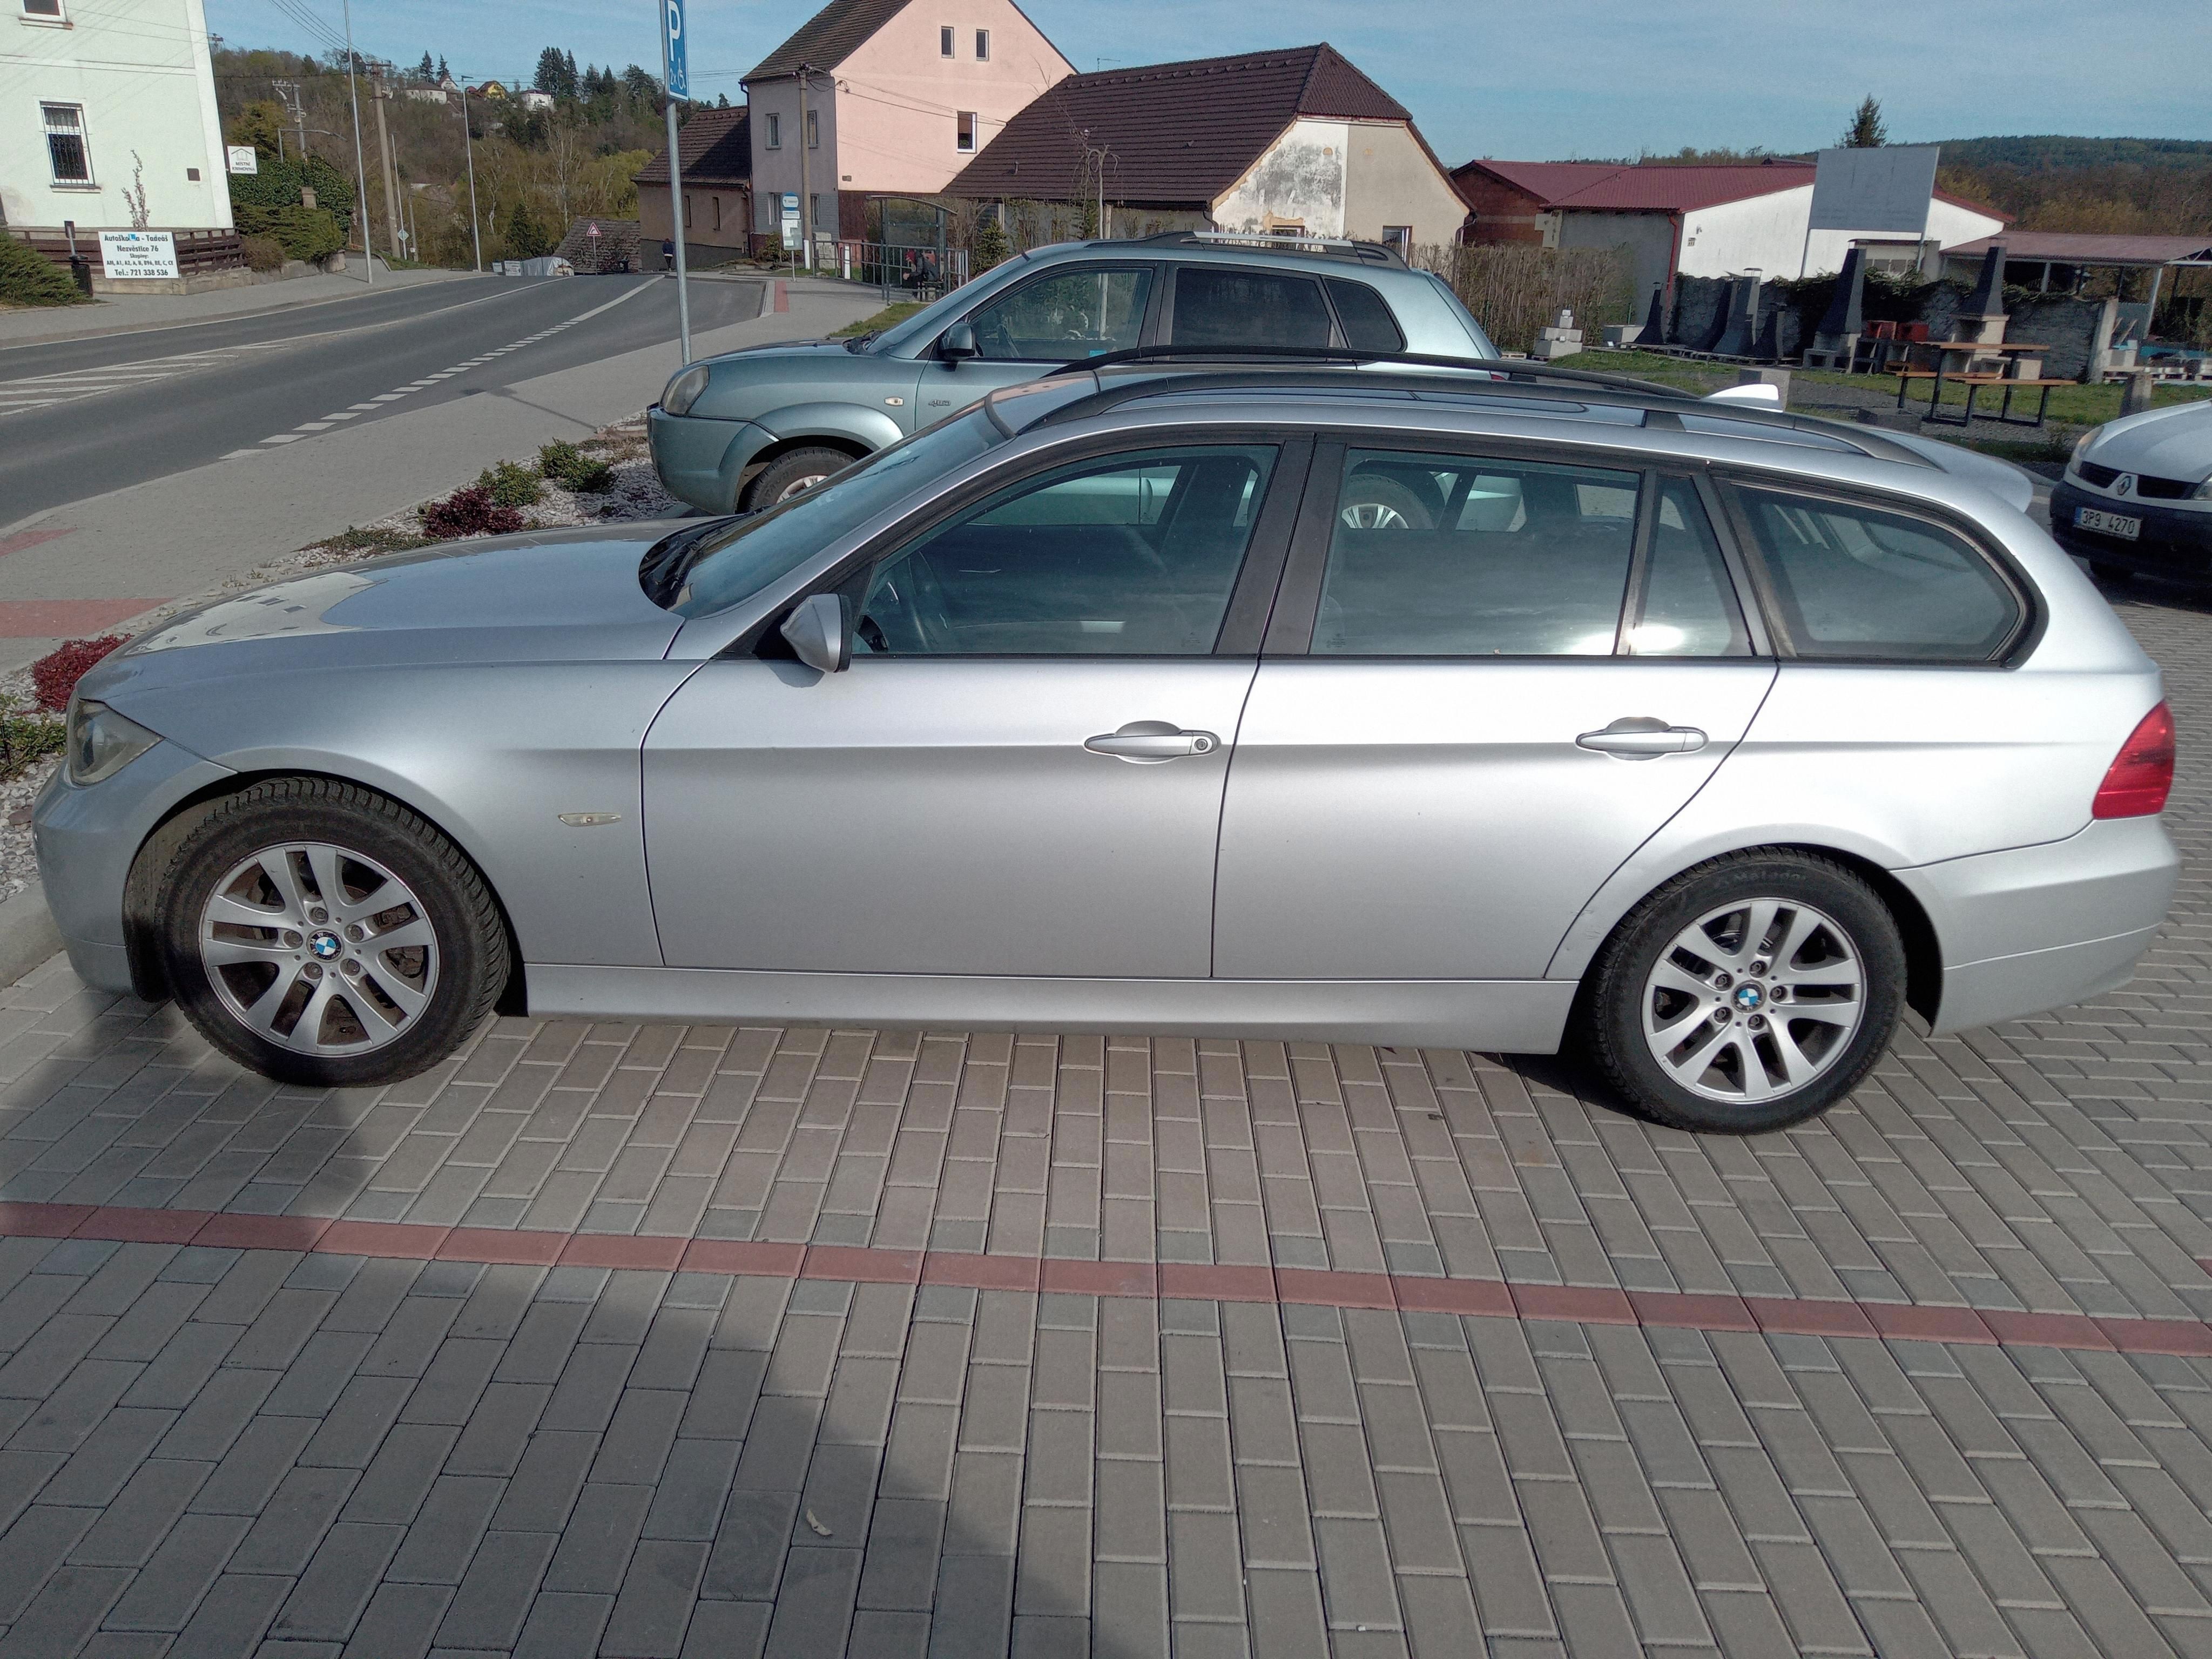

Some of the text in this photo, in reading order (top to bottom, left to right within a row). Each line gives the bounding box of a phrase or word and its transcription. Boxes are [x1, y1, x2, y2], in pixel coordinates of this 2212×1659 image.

[667, 0, 681, 62] P
[146, 234, 168, 242] Tadeáš
[2083, 510, 2135, 534] 3P9 4270
